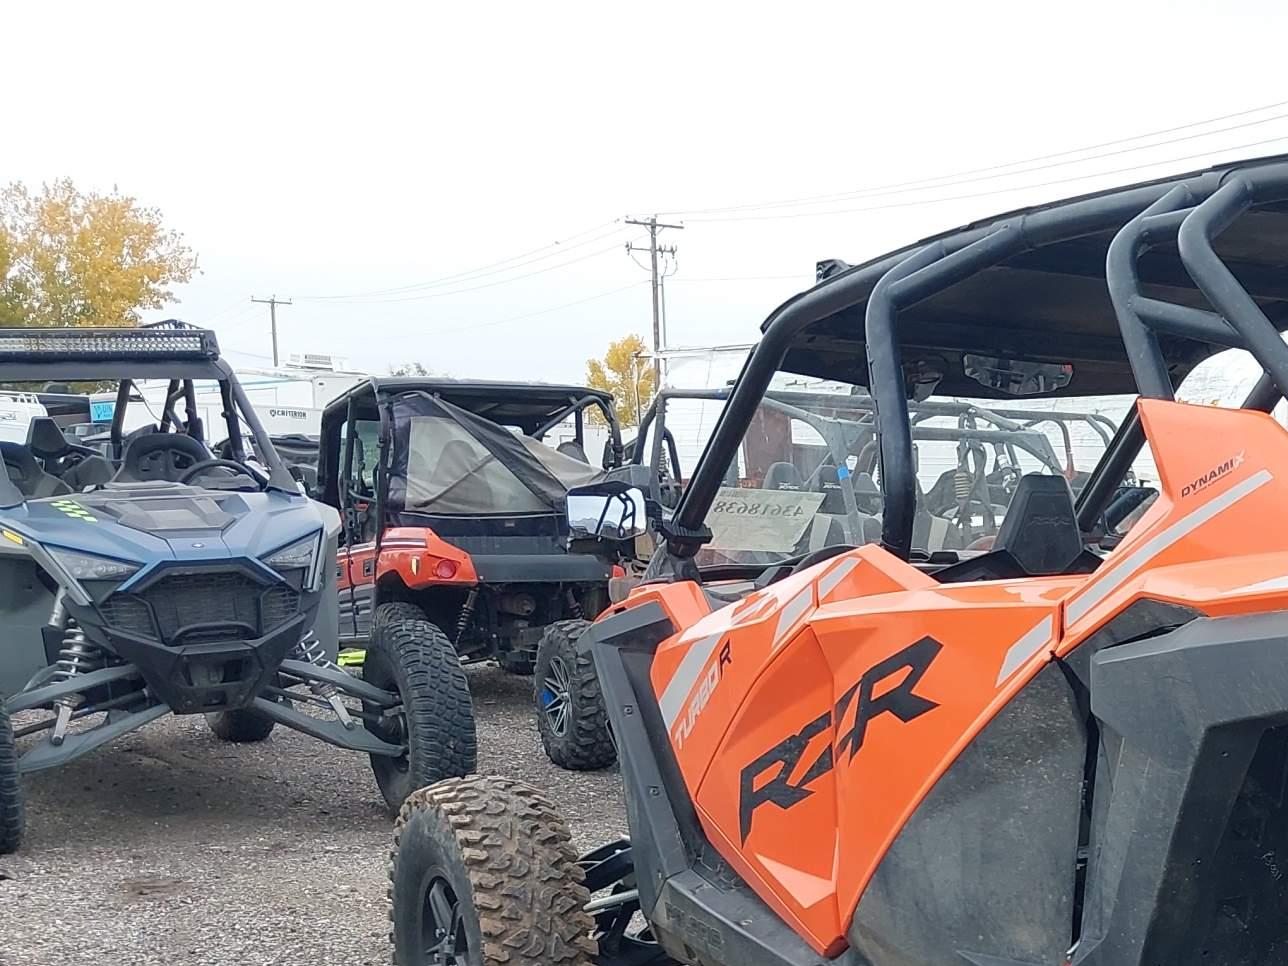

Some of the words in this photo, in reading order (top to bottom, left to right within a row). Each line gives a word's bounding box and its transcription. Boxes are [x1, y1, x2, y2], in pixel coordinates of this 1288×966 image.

[1181, 449, 1245, 498] DYNAMIX
[674, 659, 720, 750] TURBO
[719, 638, 732, 681] R
[739, 635, 944, 850] RZR
